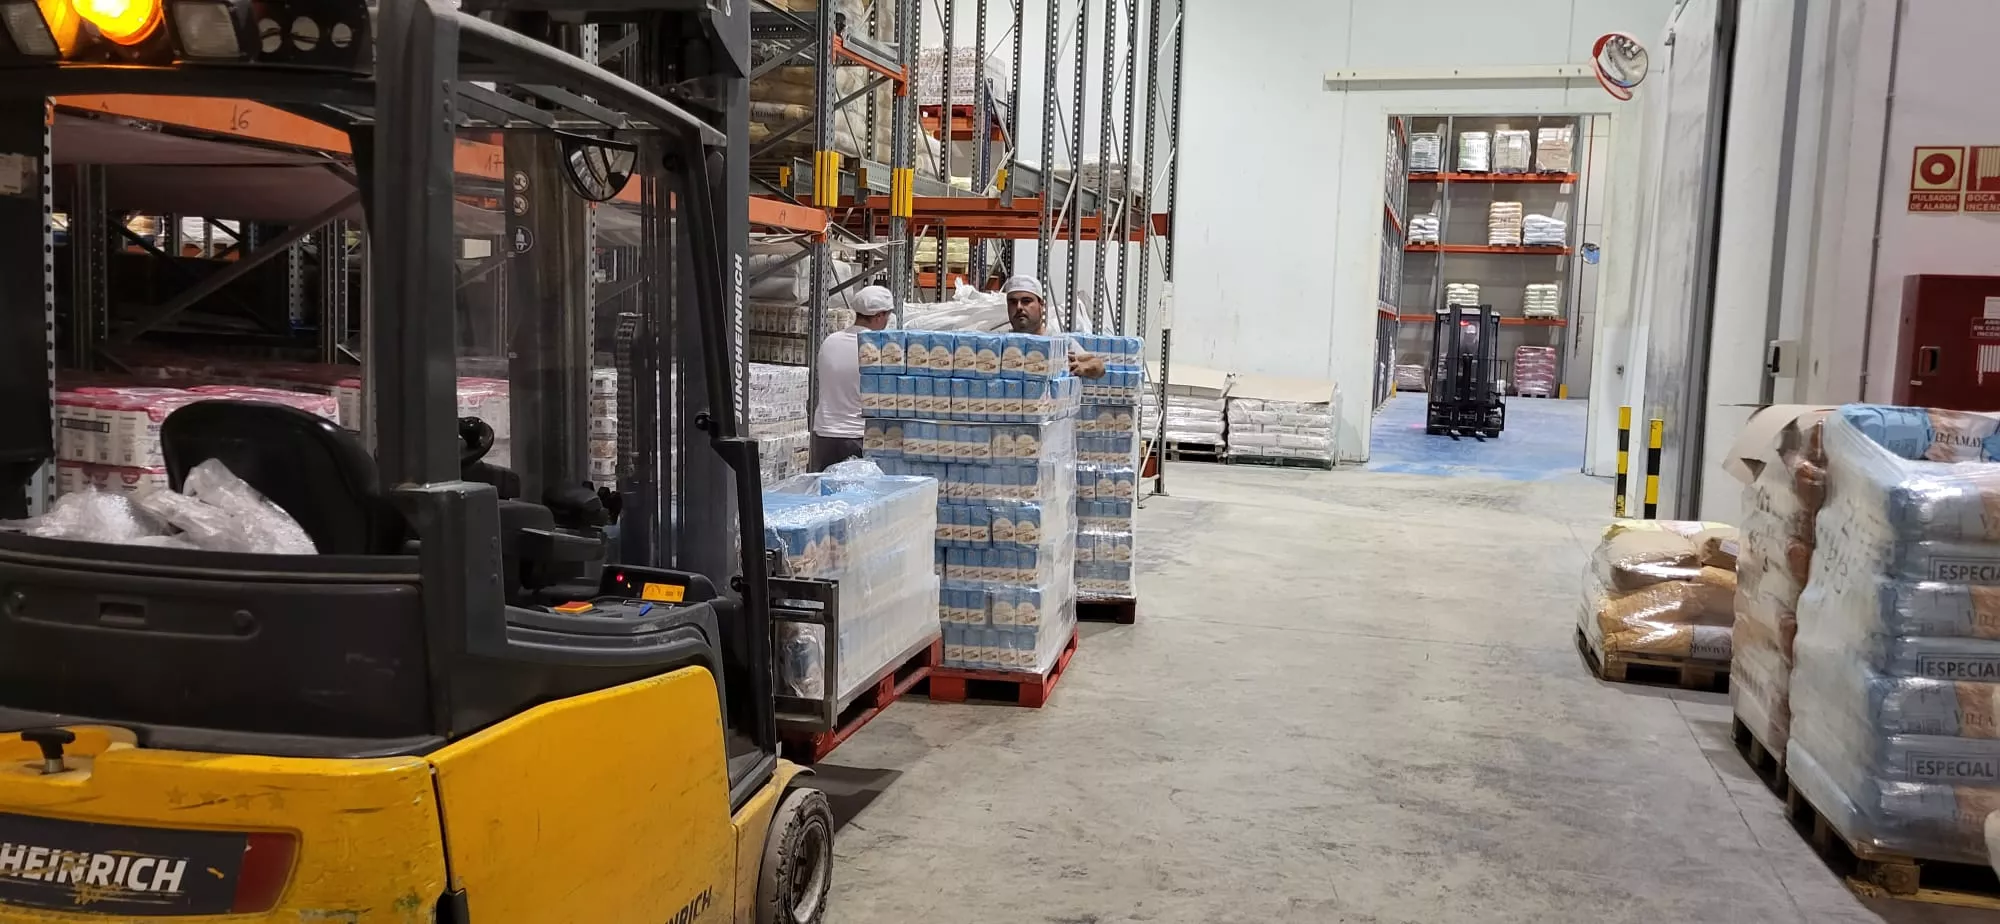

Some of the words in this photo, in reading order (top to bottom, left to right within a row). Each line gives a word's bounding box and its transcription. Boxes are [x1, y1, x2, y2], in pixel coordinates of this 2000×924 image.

[229, 103, 252, 131] 16
[1912, 194, 1958, 202] PULSADOR
[1967, 194, 1996, 202] BOCA
[734, 253, 744, 425] JUNGHEINRICH
[1915, 760, 1994, 778] ESPECIAL
[0, 842, 188, 893] HEINRICH
